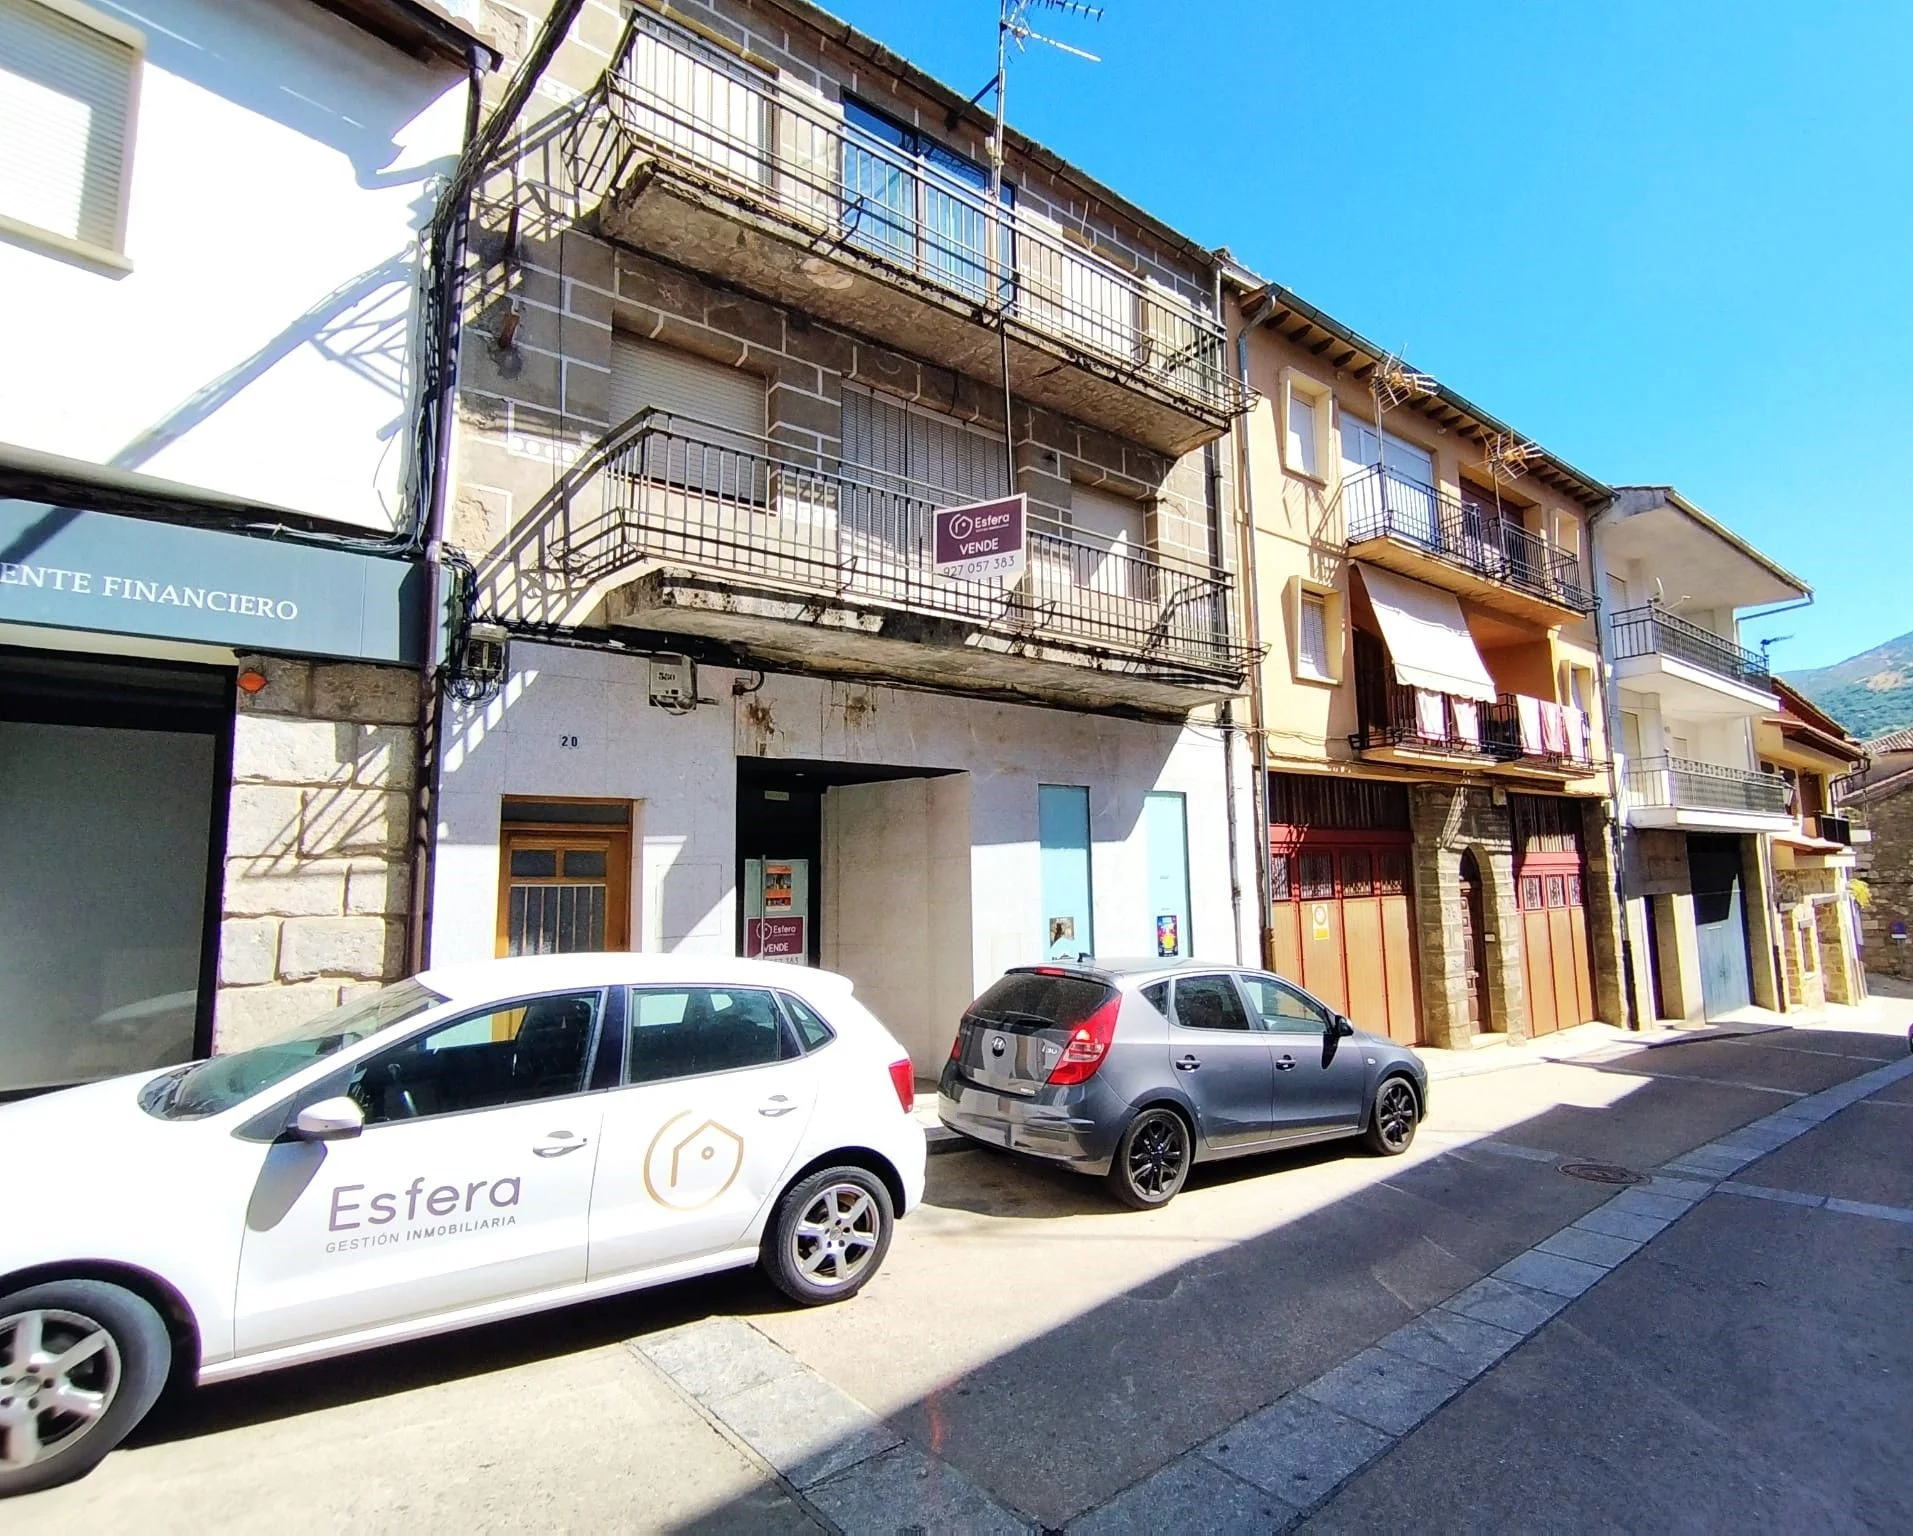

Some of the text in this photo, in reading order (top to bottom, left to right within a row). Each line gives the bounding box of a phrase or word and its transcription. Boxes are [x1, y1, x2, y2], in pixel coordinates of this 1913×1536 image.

[975, 513, 1010, 529] Esfera
[959, 538, 999, 555] VENDE
[967, 561, 989, 574] 057
[993, 556, 1015, 570] 383
[102, 576, 298, 620] FINANCIERO
[561, 736, 578, 747] 20
[328, 1176, 521, 1232] Esfera
[326, 1214, 517, 1254] GESTIÓN INMOBILIARIA
